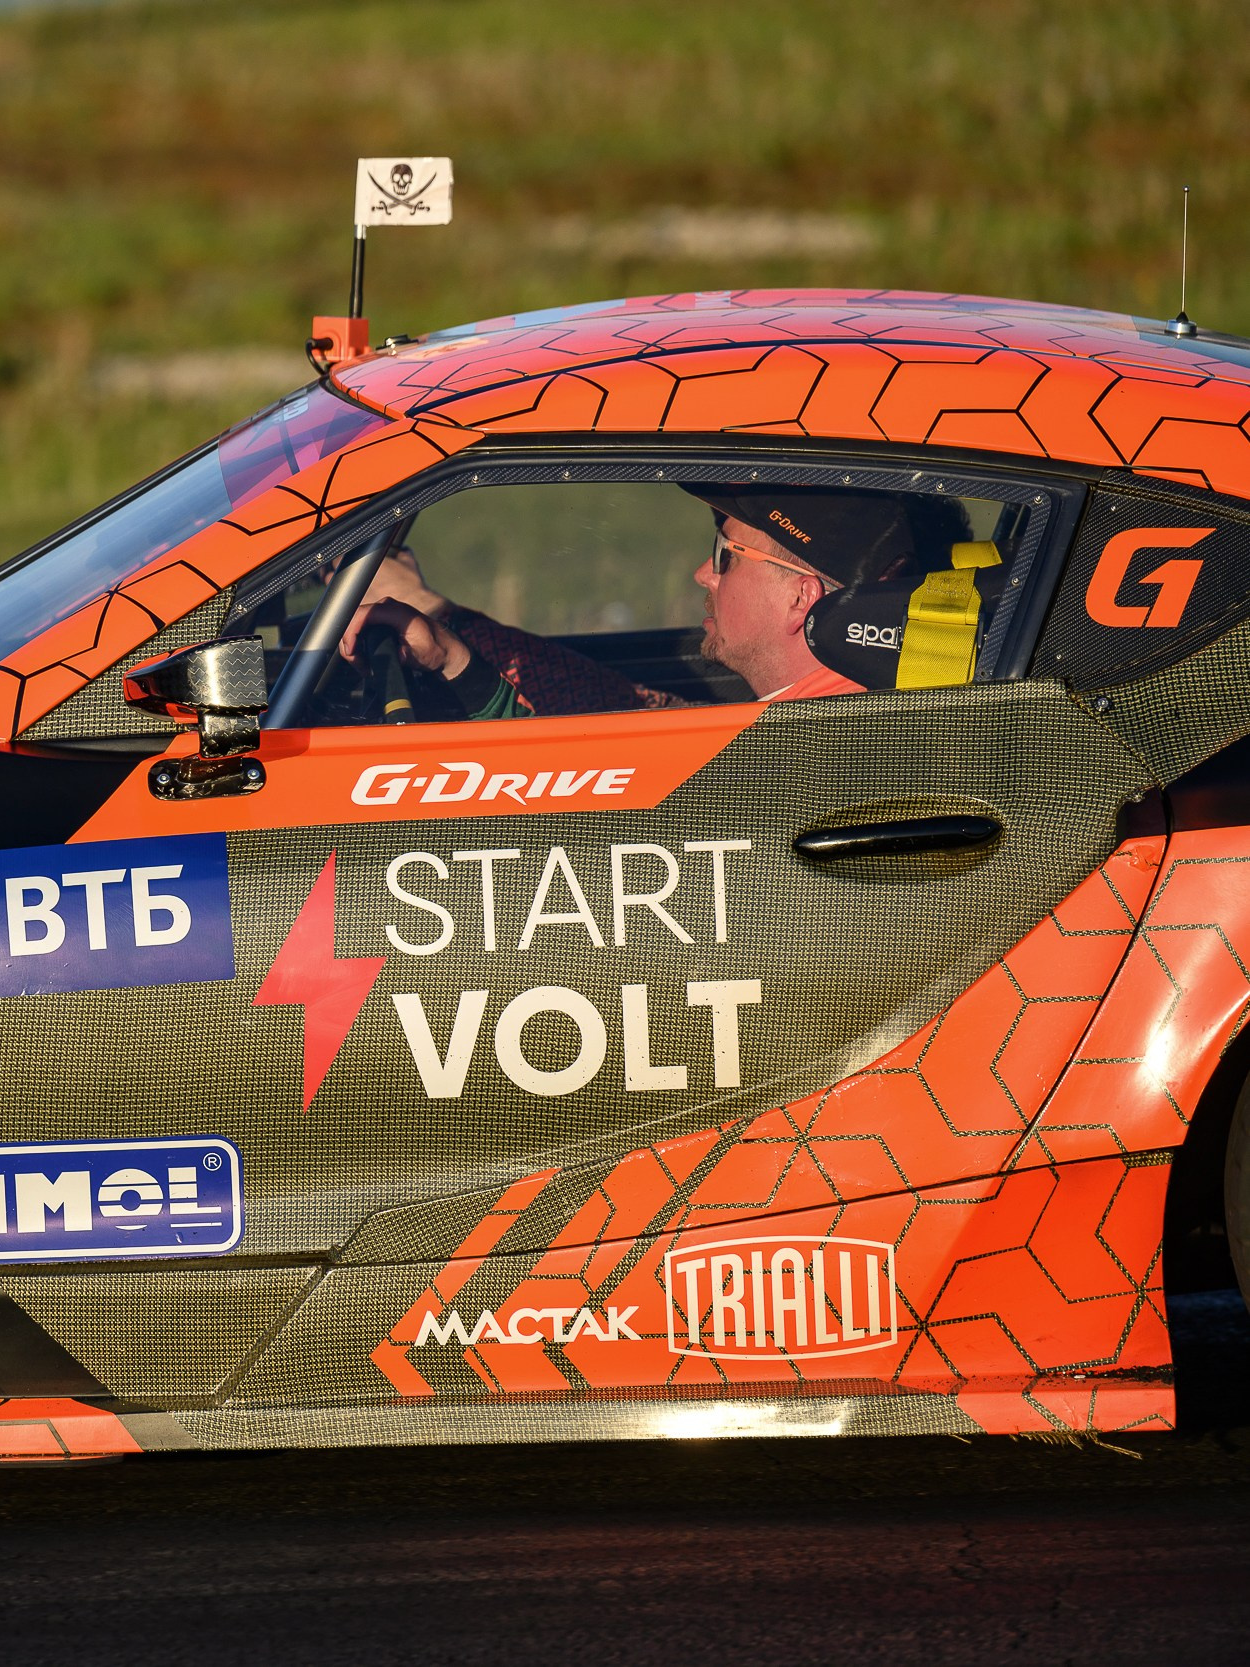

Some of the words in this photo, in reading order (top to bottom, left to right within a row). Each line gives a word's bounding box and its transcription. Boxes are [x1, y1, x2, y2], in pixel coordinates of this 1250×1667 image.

[5, 864, 192, 957] ВТБ
[384, 840, 752, 956] START
[391, 979, 762, 1098] VOLT
[676, 1247, 883, 1347] TRIALLI
